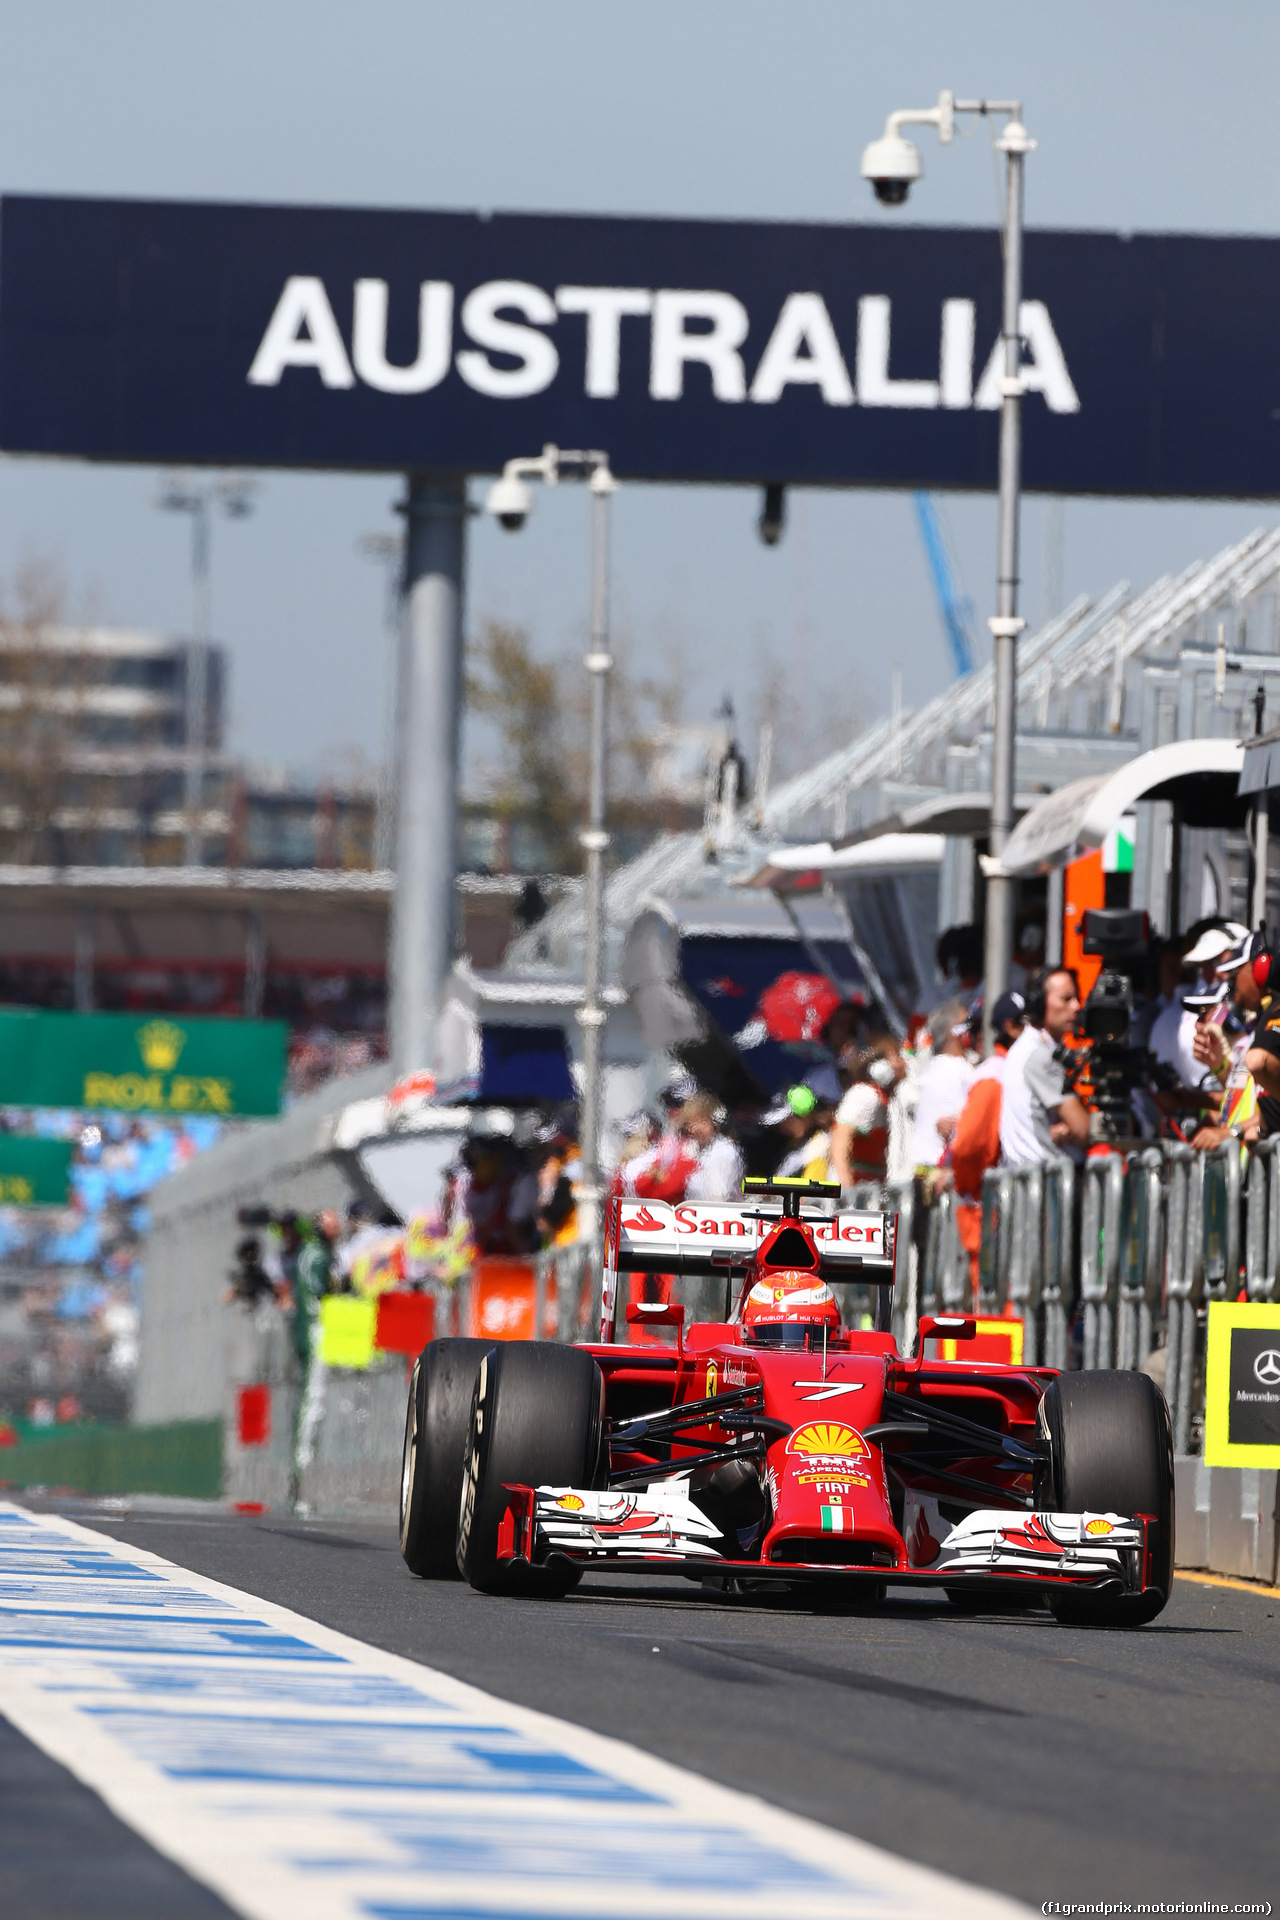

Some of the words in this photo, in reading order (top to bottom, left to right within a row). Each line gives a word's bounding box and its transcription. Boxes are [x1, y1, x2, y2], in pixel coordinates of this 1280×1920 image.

[247, 275, 1081, 414] AUSTRALIA
[792, 1381, 866, 1401] 7
[792, 1466, 864, 1477] KASPERSKY
[815, 1482, 851, 1494] FIAT
